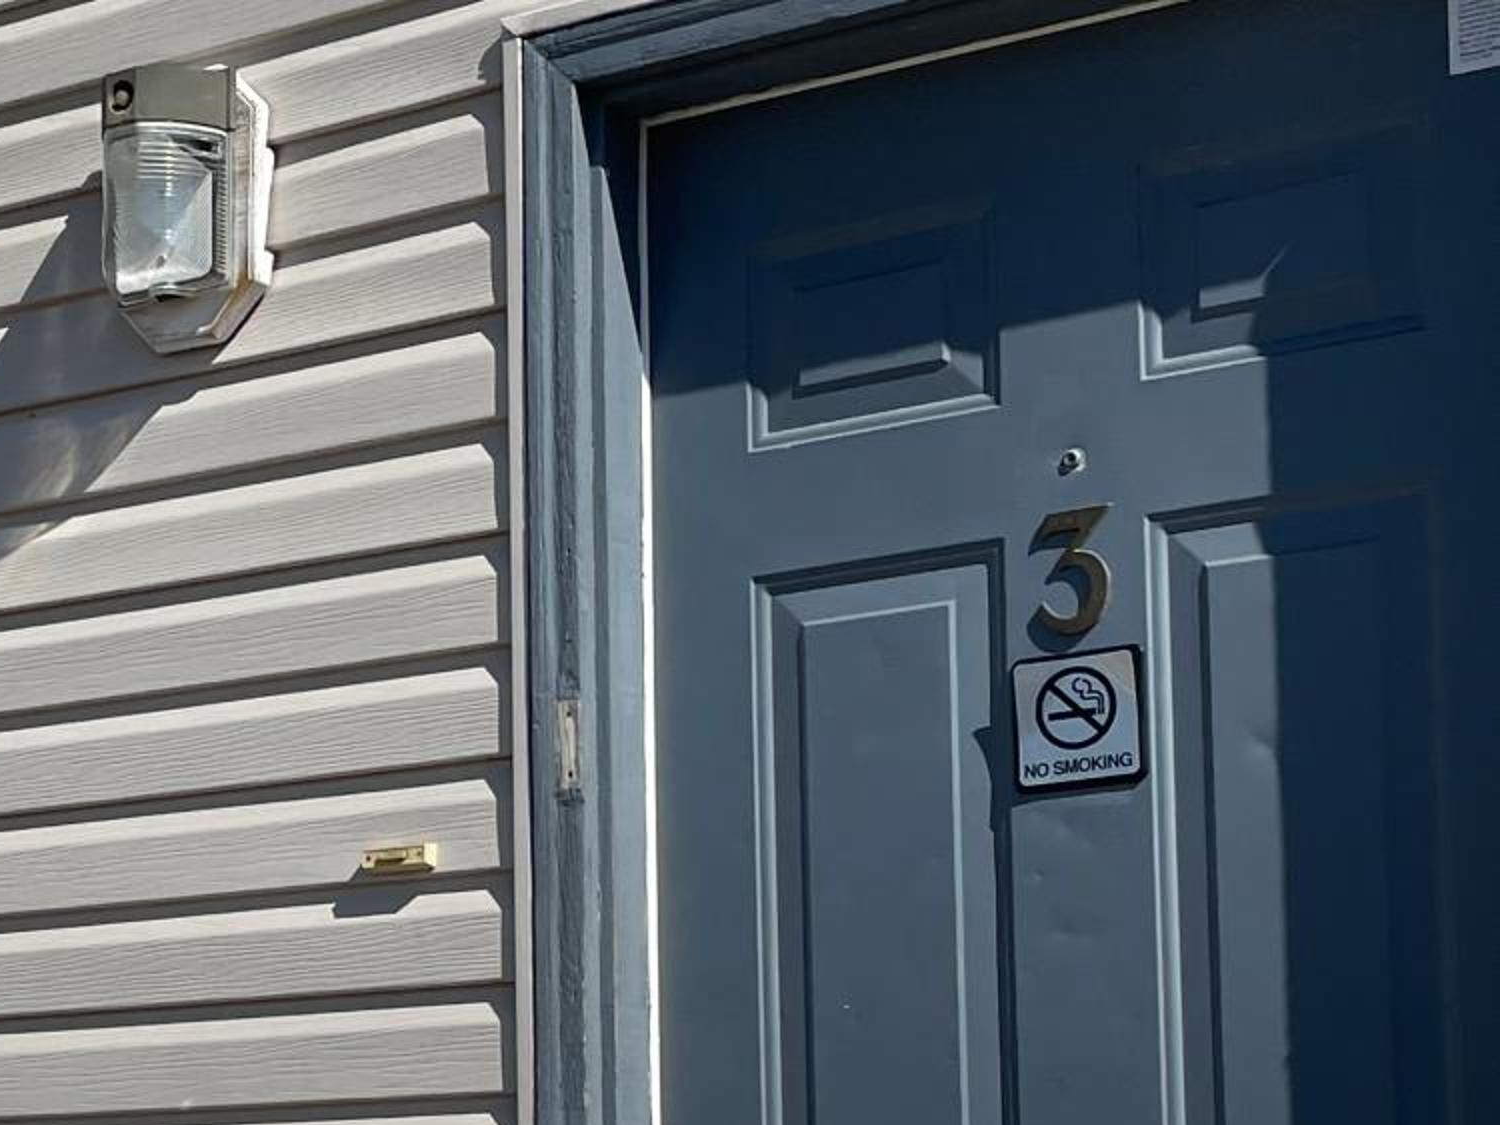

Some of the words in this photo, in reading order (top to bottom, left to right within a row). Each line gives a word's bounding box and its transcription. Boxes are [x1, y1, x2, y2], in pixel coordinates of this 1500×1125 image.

[1026, 503, 1112, 636] 3
[1024, 763, 1049, 778] NO
[1053, 752, 1133, 775] SMOKING
